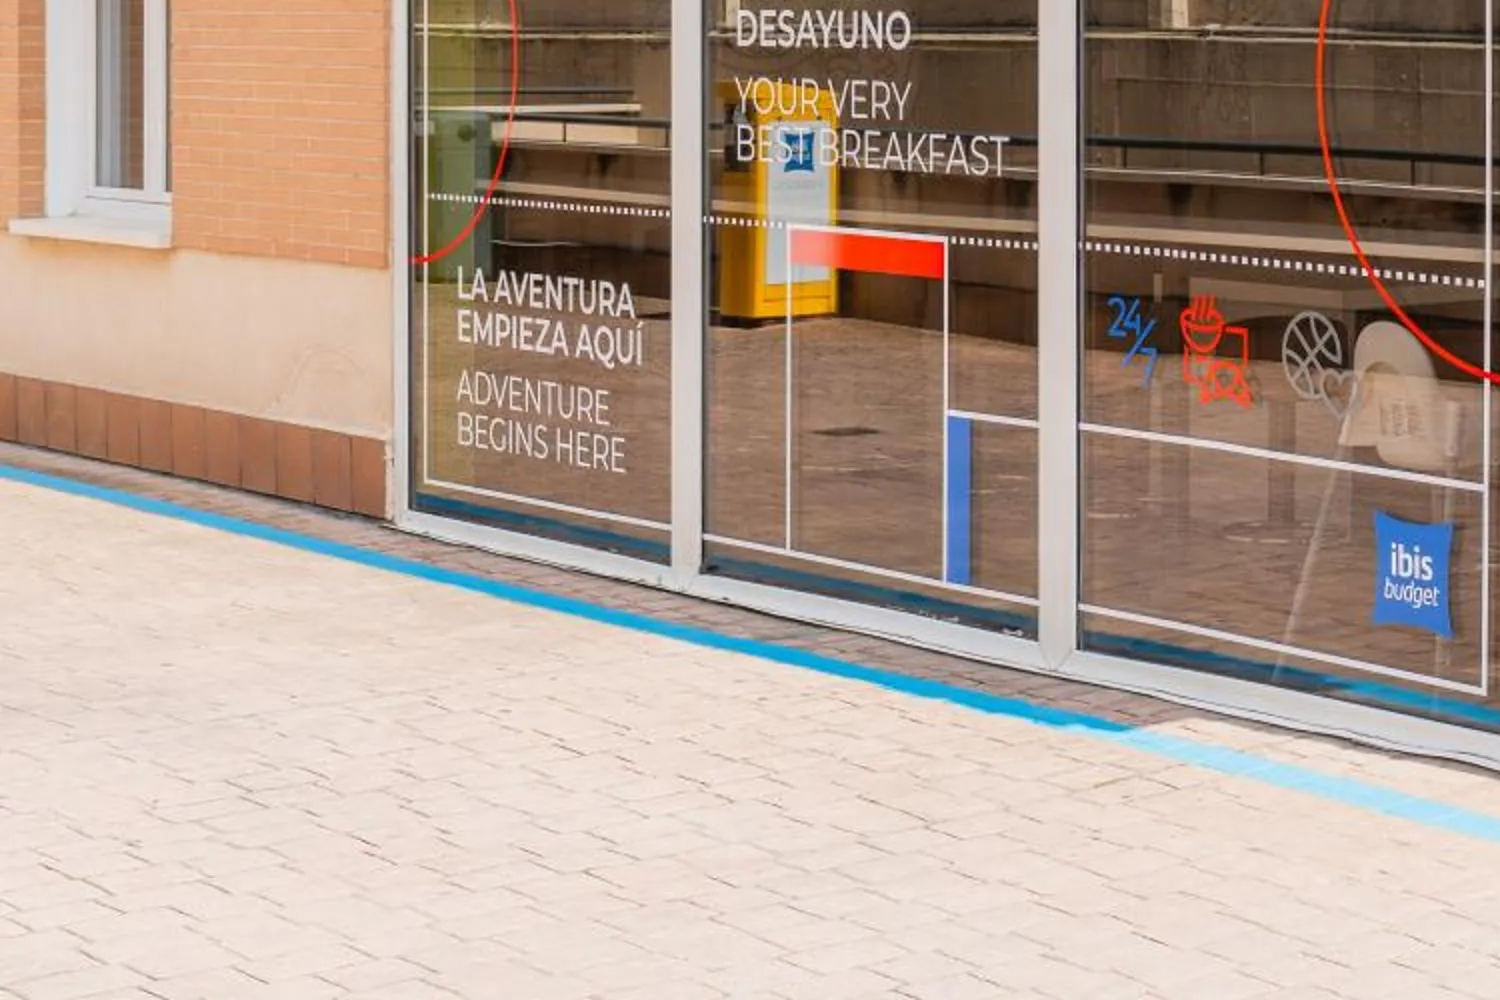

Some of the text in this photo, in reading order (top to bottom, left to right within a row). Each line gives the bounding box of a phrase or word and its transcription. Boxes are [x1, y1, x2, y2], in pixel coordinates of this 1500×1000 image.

[736, 9, 912, 51] DESAYUNO
[734, 76, 913, 122] YOUR VERY
[736, 123, 810, 164] BEST
[819, 127, 1010, 178] BREAKFAST
[457, 265, 637, 320] LA AVENTURA
[457, 308, 645, 370] EMPIEZA AQUÍ
[456, 369, 611, 427] ADVENTURE
[457, 411, 628, 475] BEGINS HERE
[1390, 541, 1434, 581] ibis
[1383, 575, 1441, 609] budget
